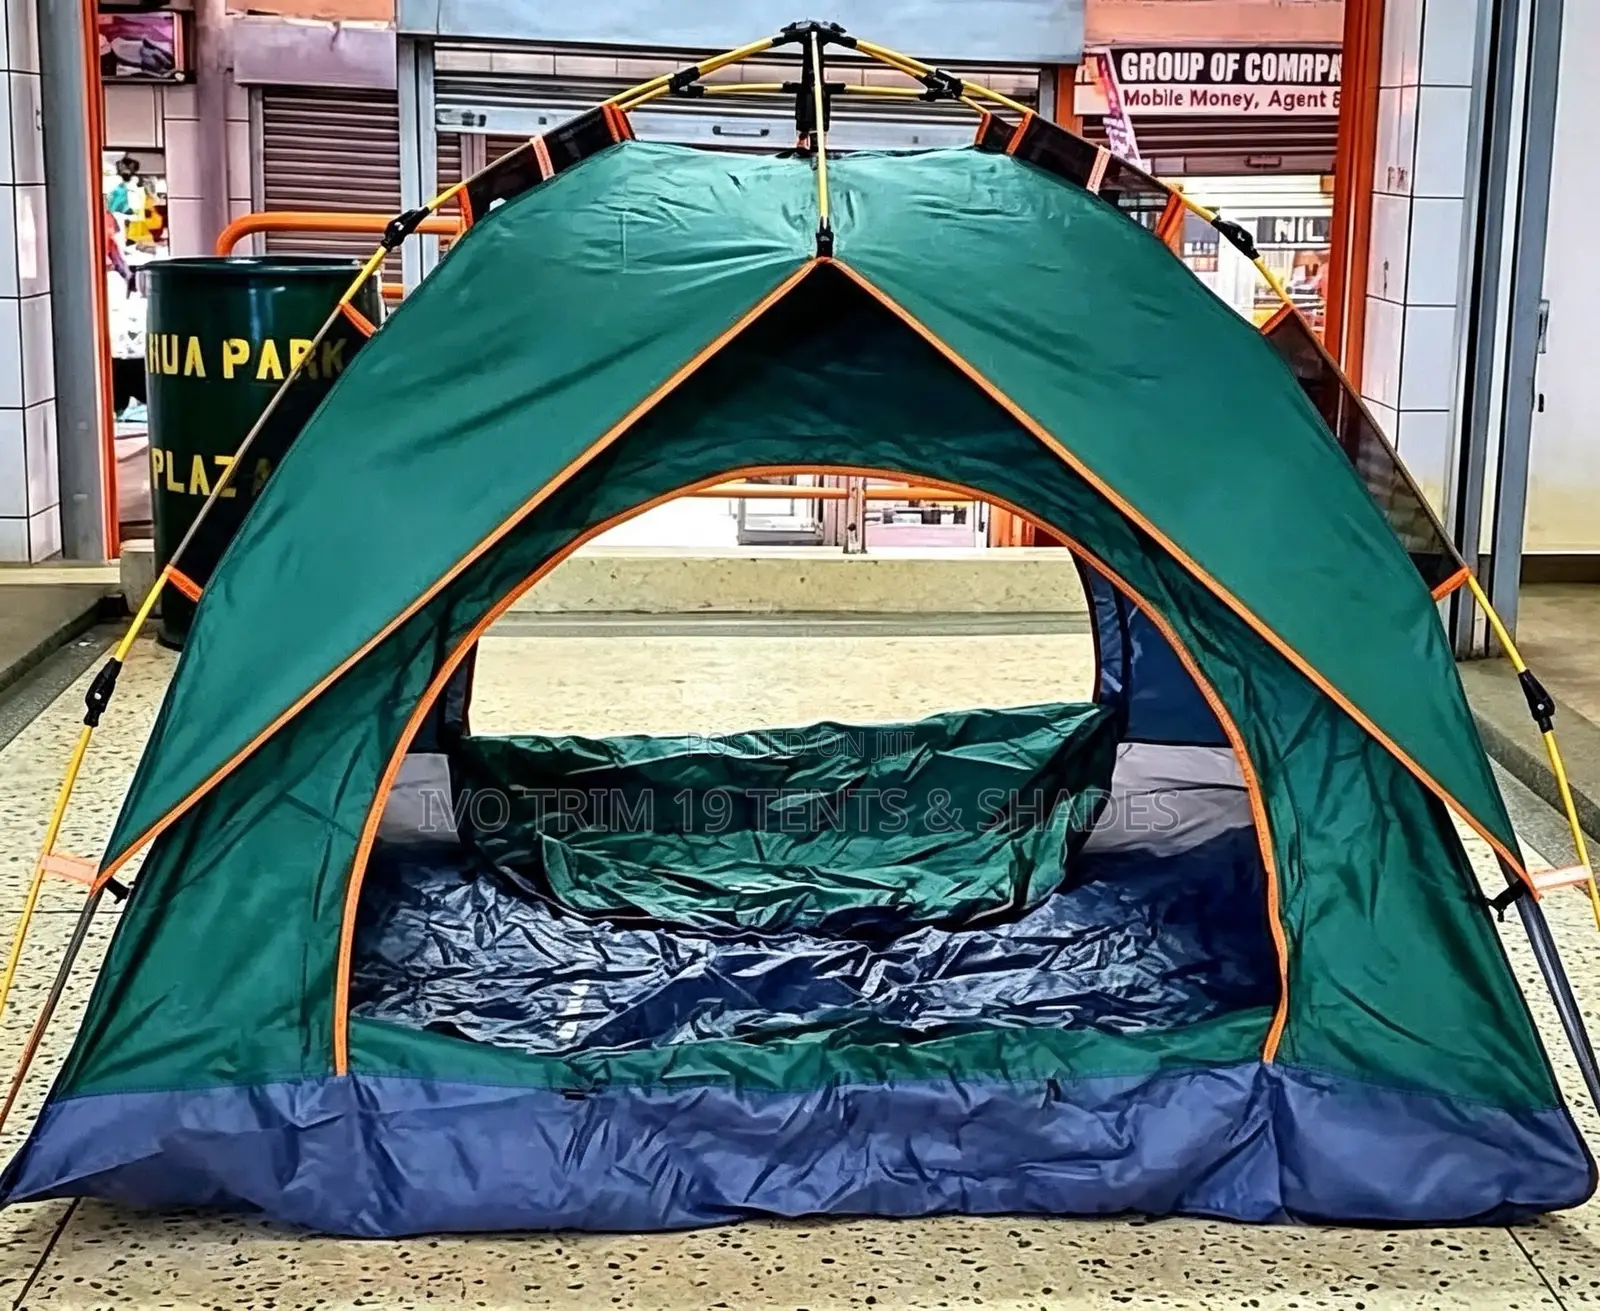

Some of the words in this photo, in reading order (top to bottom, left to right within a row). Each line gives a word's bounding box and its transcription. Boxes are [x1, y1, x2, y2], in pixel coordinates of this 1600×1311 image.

[1121, 52, 1204, 82] GROUP
[1210, 53, 1240, 82] OF
[1245, 52, 1342, 82] COMRPA
[1123, 88, 1183, 107] Mobile
[1190, 89, 1259, 111] Money,
[1268, 90, 1327, 110] Agent
[222, 338, 347, 380] PARK
